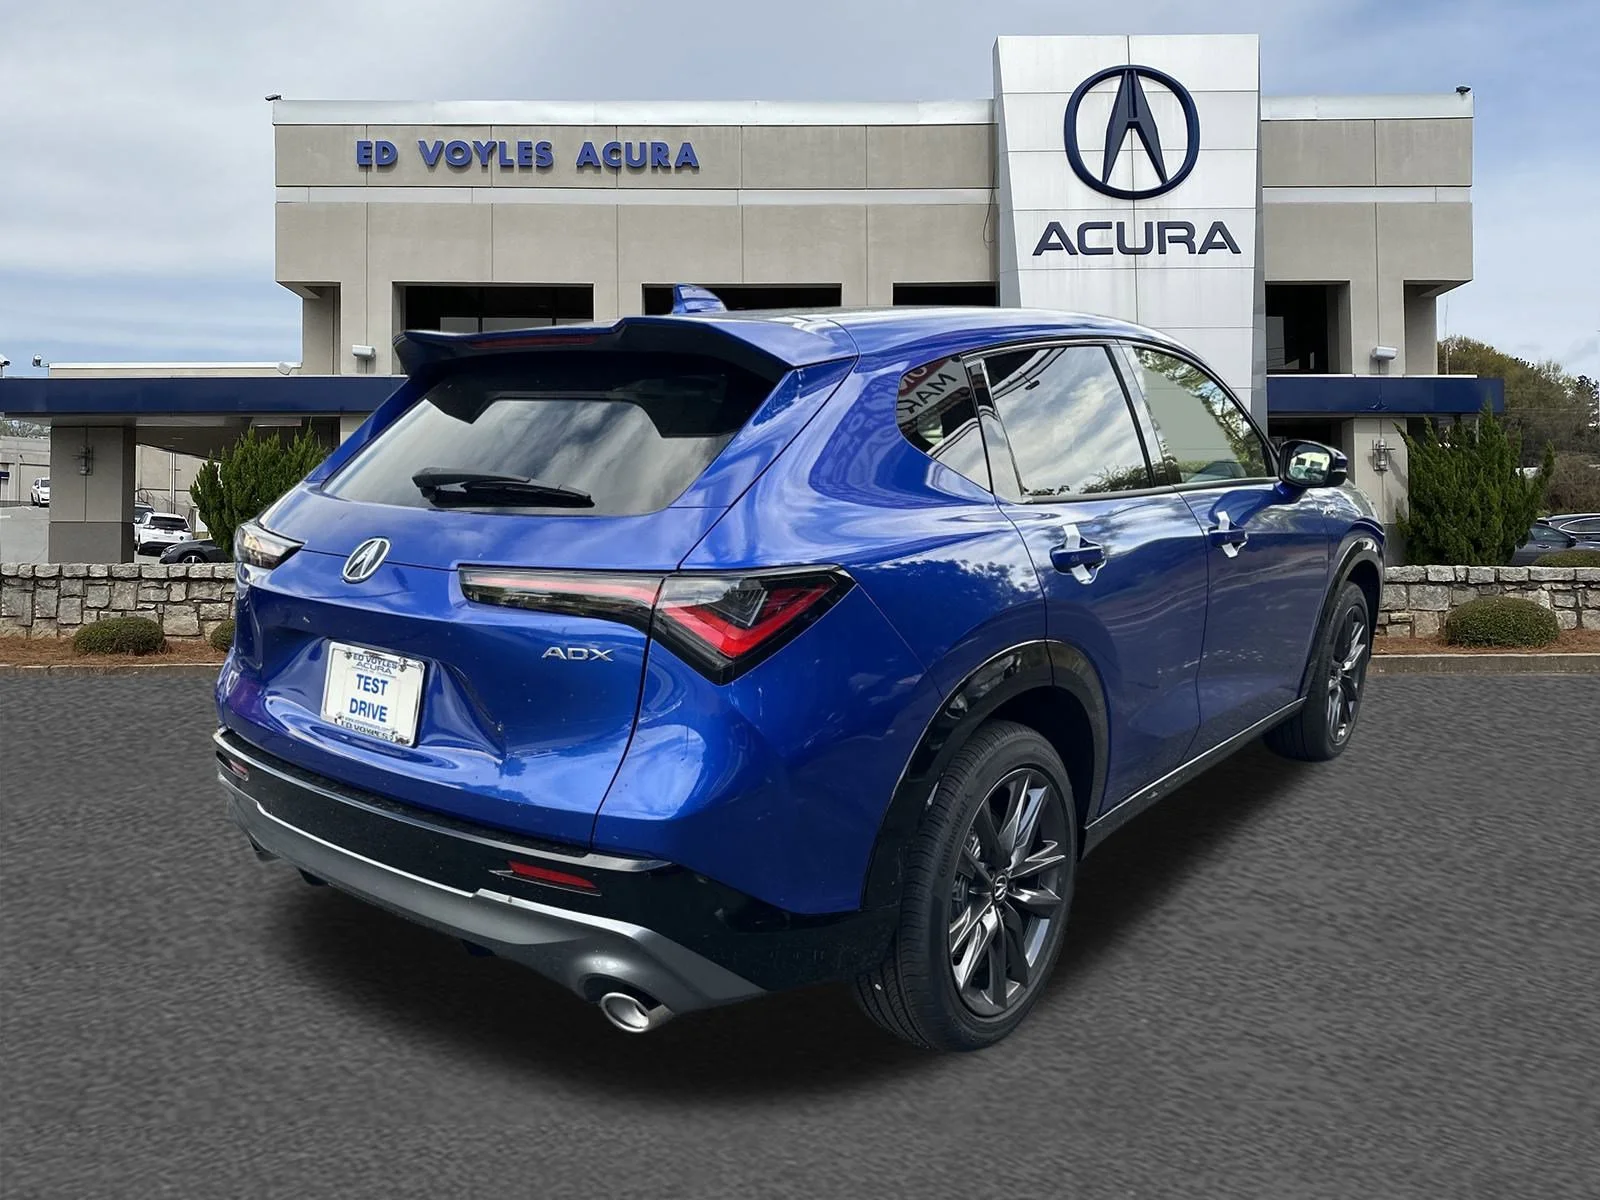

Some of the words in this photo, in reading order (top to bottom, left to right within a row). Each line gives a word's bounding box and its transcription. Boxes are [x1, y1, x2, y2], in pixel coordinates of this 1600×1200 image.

[357, 140, 398, 167] ED
[418, 140, 554, 167] VOYLES
[576, 141, 700, 168] ACURA
[1032, 221, 1242, 256] ACURA
[353, 653, 364, 661] ED
[365, 655, 398, 670] VOYLES
[541, 646, 614, 662] ADX
[356, 661, 393, 675] ACURA
[356, 673, 388, 696] TEST
[349, 697, 388, 723] DRIVE
